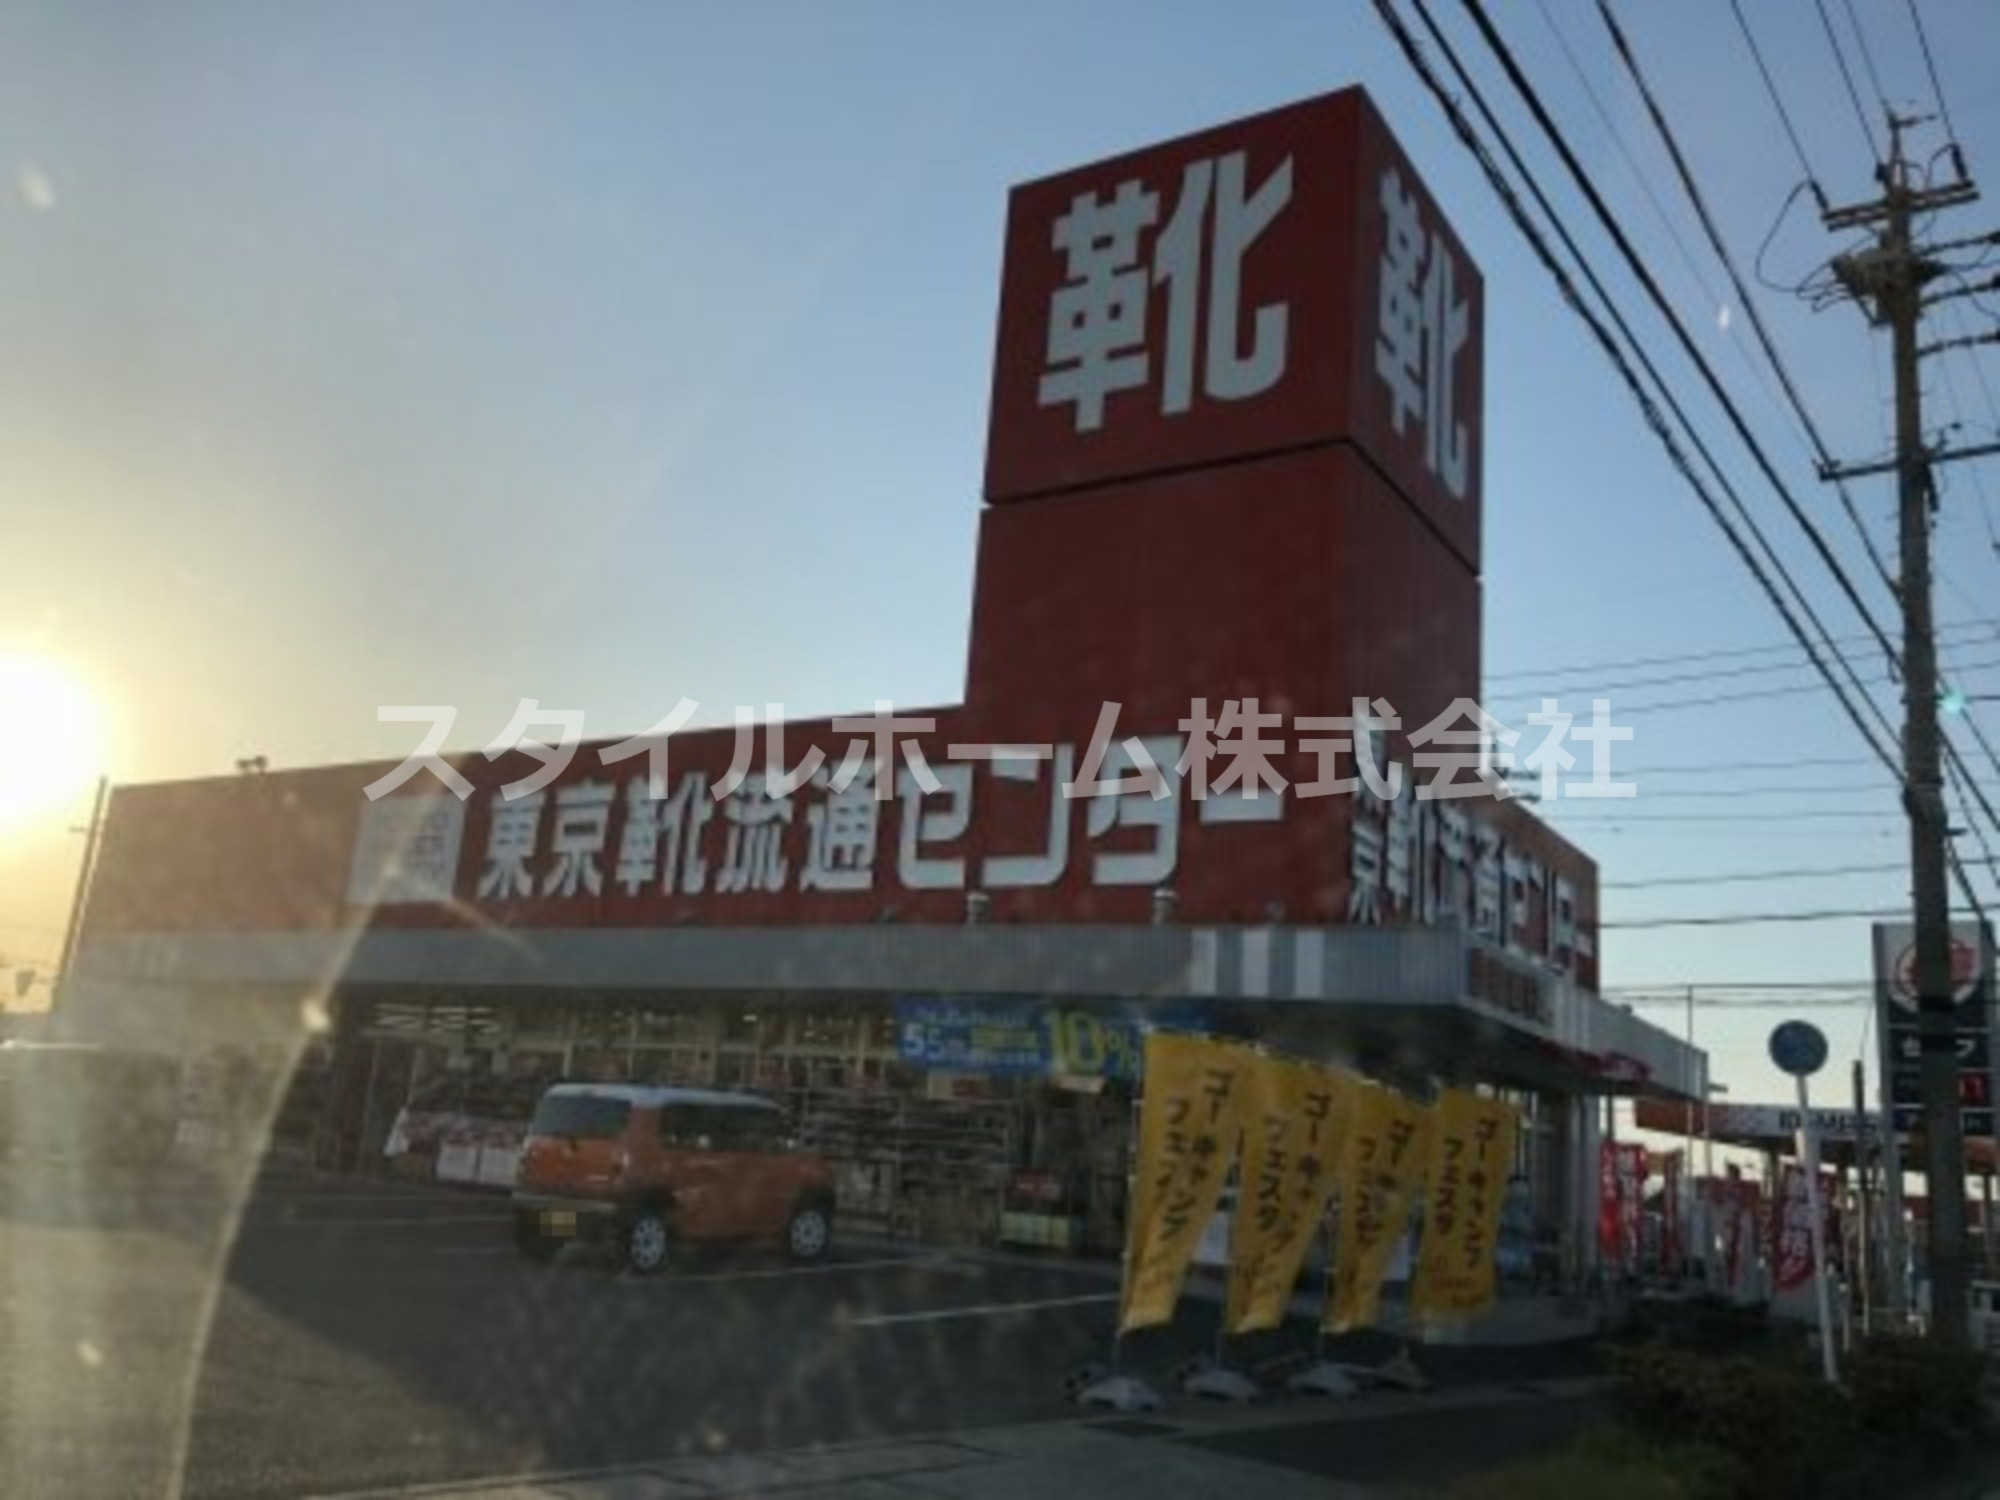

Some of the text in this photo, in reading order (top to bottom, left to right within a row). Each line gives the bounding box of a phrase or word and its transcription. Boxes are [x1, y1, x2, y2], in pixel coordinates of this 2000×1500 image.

[1038, 150, 1293, 433] 靴
[1375, 165, 1469, 498] 靴
[477, 736, 1283, 898] 東京靴流通センター
